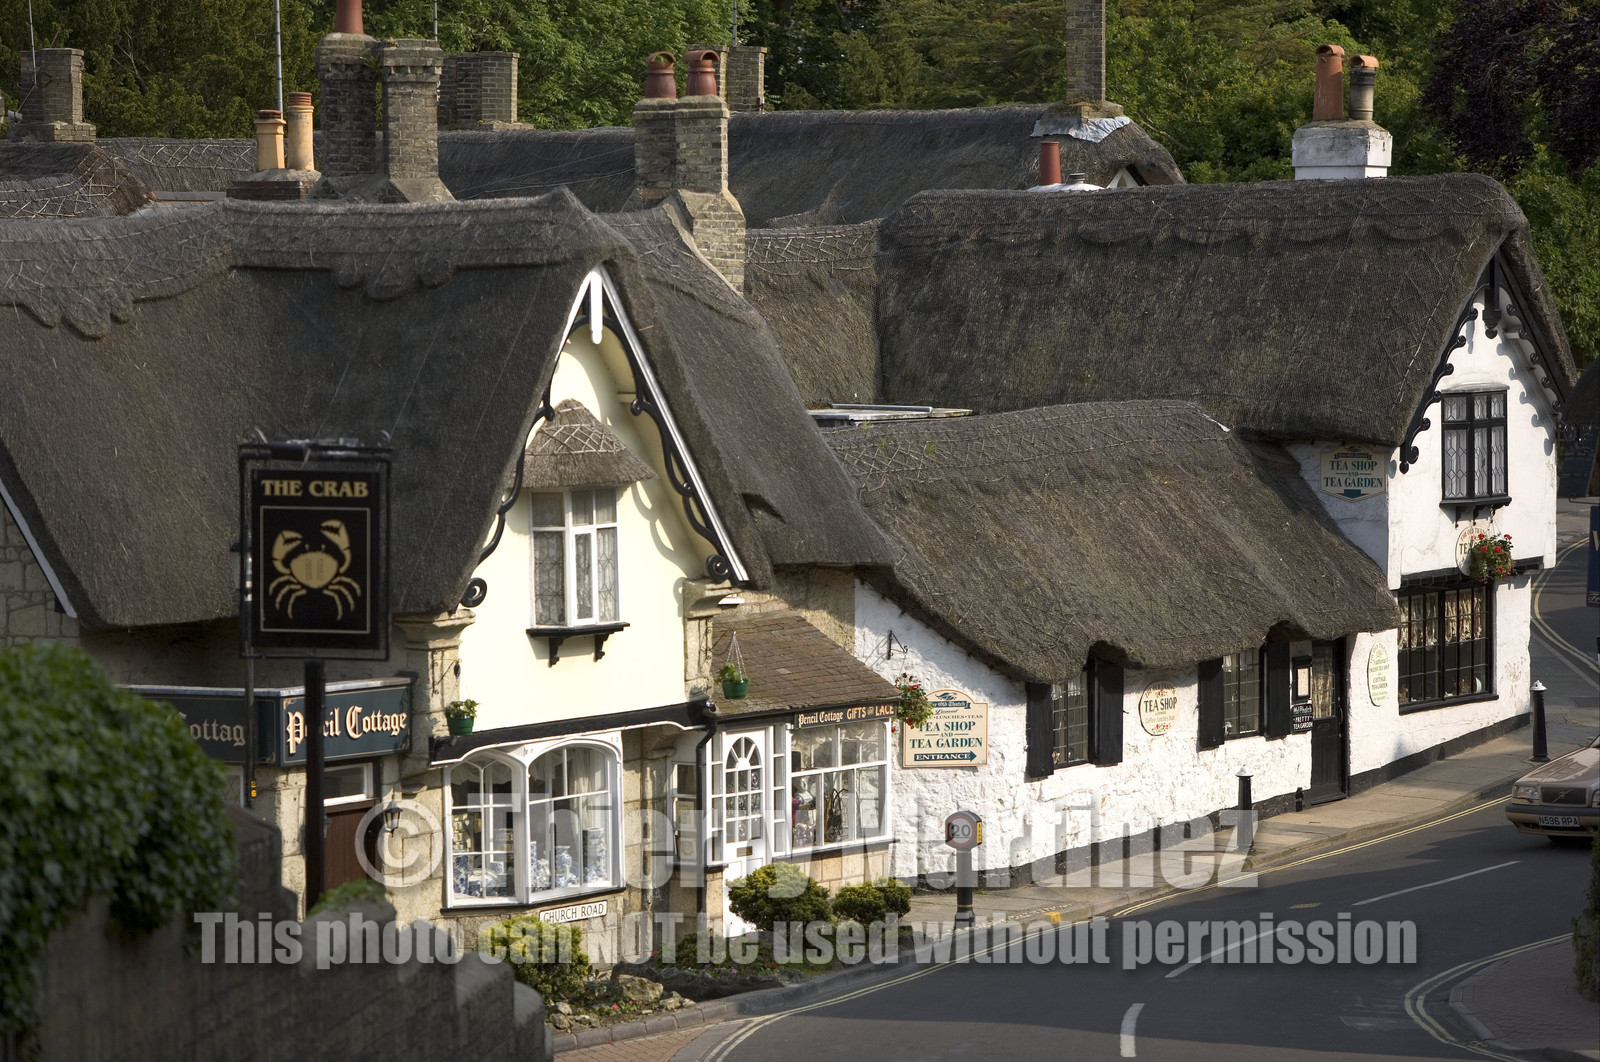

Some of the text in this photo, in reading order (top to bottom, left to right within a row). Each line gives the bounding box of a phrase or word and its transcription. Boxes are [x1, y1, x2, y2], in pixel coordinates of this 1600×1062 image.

[1330, 460, 1377, 471] TEA SHOP
[261, 479, 369, 498] THE CRAB
[1324, 477, 1383, 488] TEA GARDEN
[1144, 697, 1178, 713] TEA SHOP
[798, 712, 819, 728] Pencil
[819, 711, 843, 723] Cottage
[846, 706, 867, 720] GIFTS
[875, 704, 895, 717] LACE
[286, 705, 407, 754] Pcil Cottage
[918, 721, 976, 732] TEA SHOP
[910, 737, 983, 749] TEA GARDEN
[1561, 817, 1579, 826] RPA
[951, 824, 971, 837] 20
[543, 903, 604, 922] CHURCH ROAD
